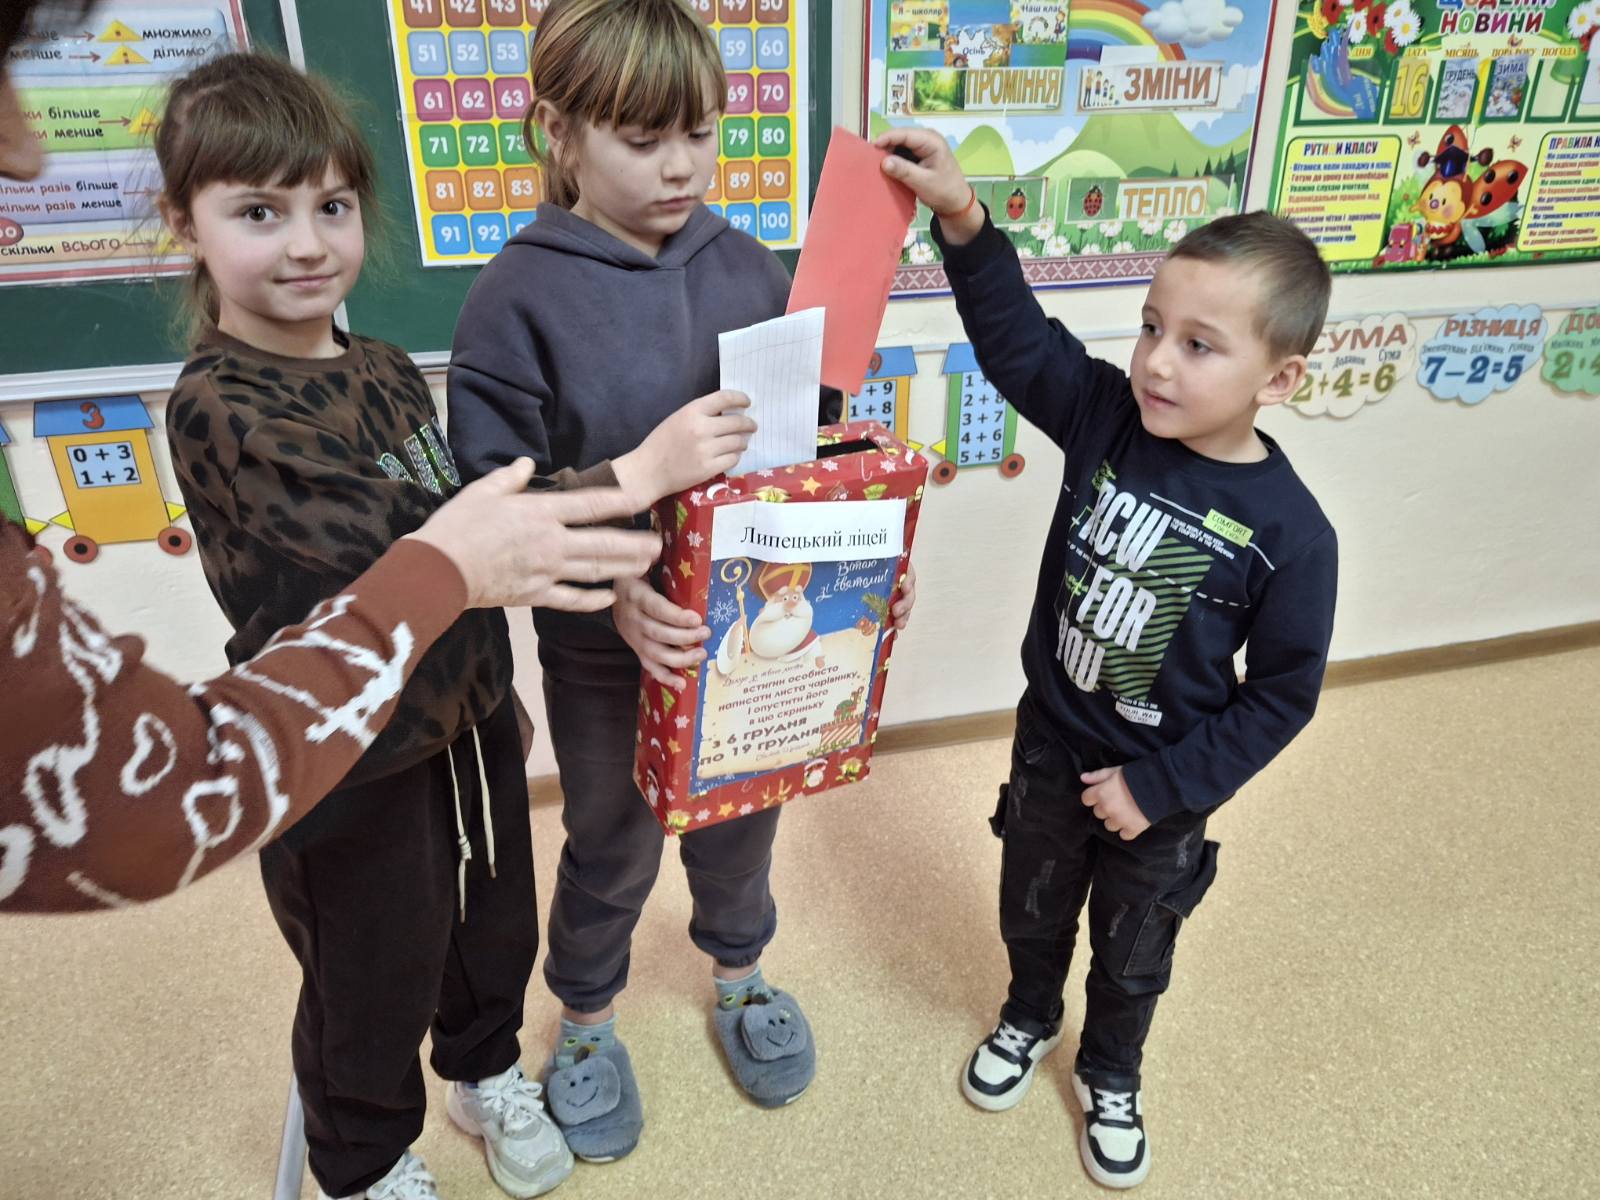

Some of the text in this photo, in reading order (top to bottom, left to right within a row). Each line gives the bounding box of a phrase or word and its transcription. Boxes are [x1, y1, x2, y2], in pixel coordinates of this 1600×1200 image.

[411, 0, 432, 13] 41
[451, 0, 475, 13] 42
[491, 0, 516, 13] 43
[1022, 4, 1041, 13] Наш
[1440, 11, 1544, 33] НОВИНИ
[142, 27, 212, 40] множимо
[153, 46, 206, 60] ділимо
[418, 45, 438, 62] 51
[457, 44, 480, 61] 52
[497, 43, 519, 60] 53
[726, 40, 747, 57] 59
[761, 39, 784, 57] 60
[962, 46, 986, 56] Осінь
[1498, 62, 1524, 75] ЗИМА
[966, 69, 1062, 105] ПРОМІННЯ
[1124, 66, 1212, 101] ЗМІНИ
[1392, 63, 1429, 117] 16
[423, 92, 444, 109] 61
[462, 91, 485, 109] 62
[501, 90, 524, 107] 63
[727, 86, 748, 102] 69
[762, 85, 785, 101] 70
[48, 106, 101, 119] більше
[54, 127, 104, 139] менше
[728, 129, 749, 145] 79
[762, 128, 785, 144] 80
[429, 137, 448, 154] 71
[466, 136, 490, 153] 72
[730, 172, 750, 188] 89
[763, 171, 785, 187] 90
[40, 183, 72, 197] разів
[76, 180, 119, 192] більше
[435, 182, 456, 199] 81
[473, 181, 495, 198] 82
[511, 180, 533, 196] 83
[46, 200, 77, 214] разів
[81, 200, 122, 209] менше
[1123, 186, 1206, 219] ТЕПЛО
[730, 214, 752, 231] 99
[761, 212, 789, 229] 100
[440, 226, 461, 243] 91
[477, 225, 500, 241] 92
[1, 238, 121, 256] скільки ВСЬОГО
[1443, 318, 1542, 340] РІЗНИЦЯ
[883, 381, 893, 395] 9
[965, 375, 973, 388] 1
[850, 405, 859, 417] 1
[882, 401, 892, 414] 8
[964, 395, 973, 407] 2
[80, 402, 105, 429] 3
[962, 413, 972, 426] 3
[994, 410, 1003, 423] 7
[961, 432, 971, 445] 4
[992, 429, 1002, 442] 6
[73, 448, 87, 463] 0
[117, 445, 131, 459] 3
[960, 451, 969, 463] 5
[991, 448, 1001, 461] 5
[81, 471, 94, 485] 1
[124, 467, 138, 481] 2
[740, 526, 888, 550] Липецький ліцей
[838, 560, 877, 576] Вітаю
[834, 568, 889, 592] святами!
[1076, 564, 1157, 652] FOR
[1056, 608, 1106, 693] YOU
[743, 678, 786, 694] встигни
[788, 665, 839, 682] особисто
[718, 693, 772, 712] написати
[775, 684, 806, 699] листа
[753, 695, 804, 714] опустити
[805, 688, 829, 701] його
[757, 712, 775, 725] цю
[777, 700, 825, 719] скриньку
[726, 733, 737, 744] 6
[733, 743, 752, 756] 19
